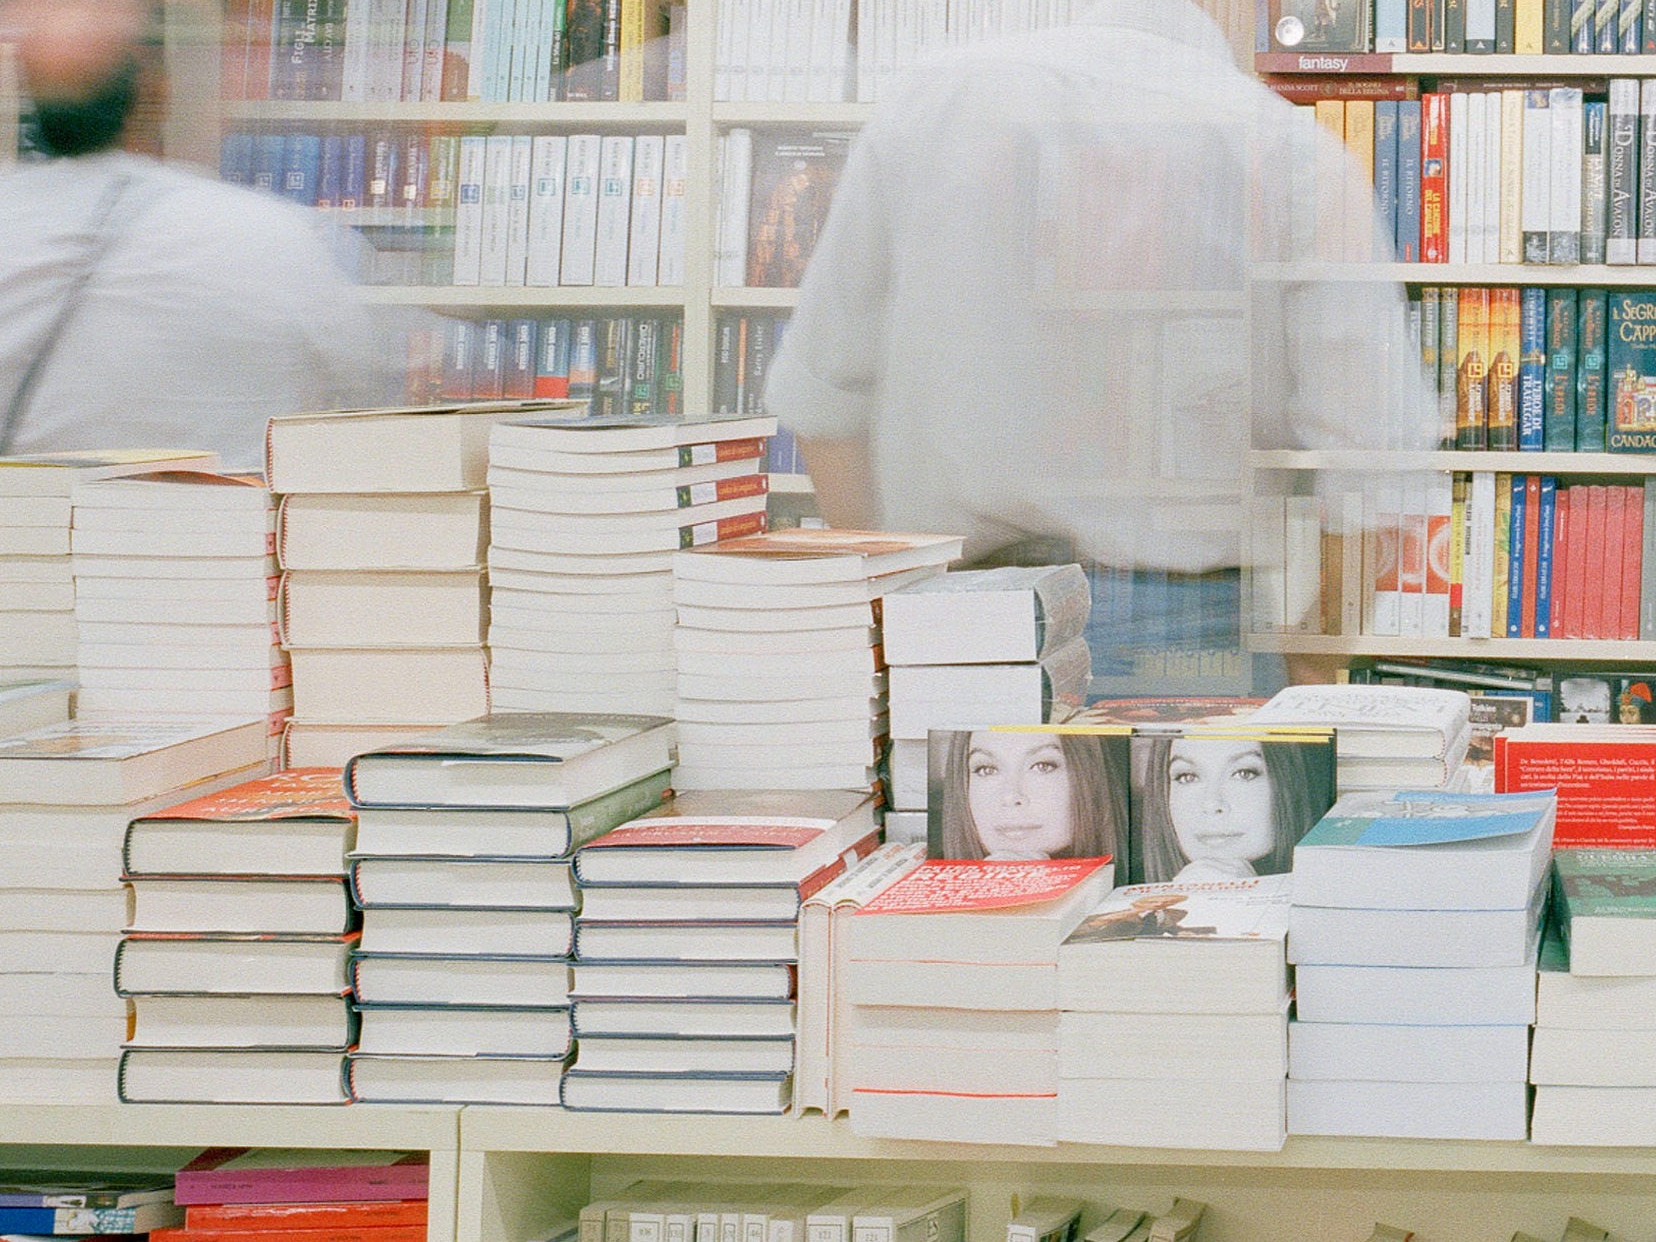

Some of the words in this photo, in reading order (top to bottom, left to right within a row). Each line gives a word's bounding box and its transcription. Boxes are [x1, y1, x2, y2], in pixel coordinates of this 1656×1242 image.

[1299, 55, 1348, 71] fantasy
[755, 325, 764, 350] Eisler
[754, 352, 763, 376] Barry
[1522, 375, 1532, 436] TRAFALGAR
